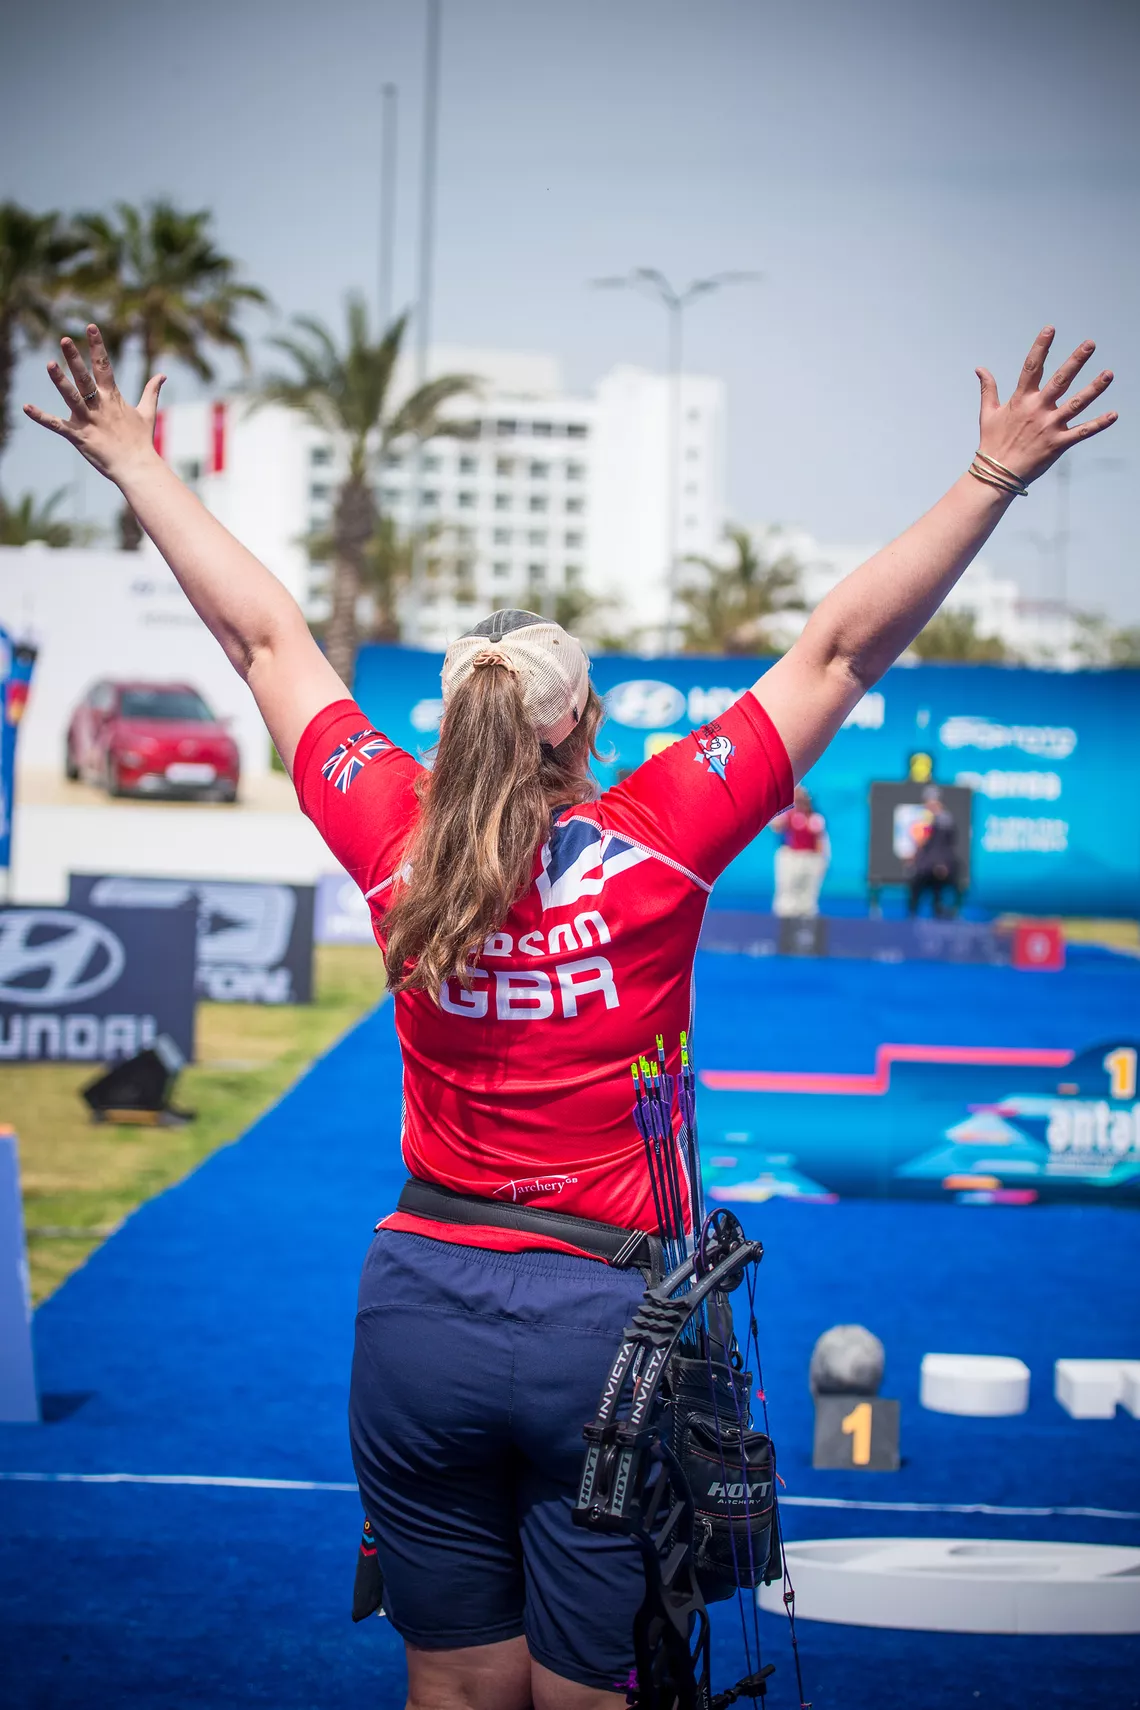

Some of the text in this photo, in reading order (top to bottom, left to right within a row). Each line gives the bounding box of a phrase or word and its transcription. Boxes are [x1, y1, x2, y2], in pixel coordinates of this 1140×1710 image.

[440, 955, 620, 1020] GBR
[1103, 1047, 1137, 1099] 1
[598, 1343, 633, 1419] INVICTA
[631, 1347, 666, 1424] INVICTA
[842, 1402, 872, 1465] 1
[580, 1447, 598, 1504] HOYT
[614, 1453, 630, 1510] HOYT
[707, 1481, 772, 1498] HOYT
